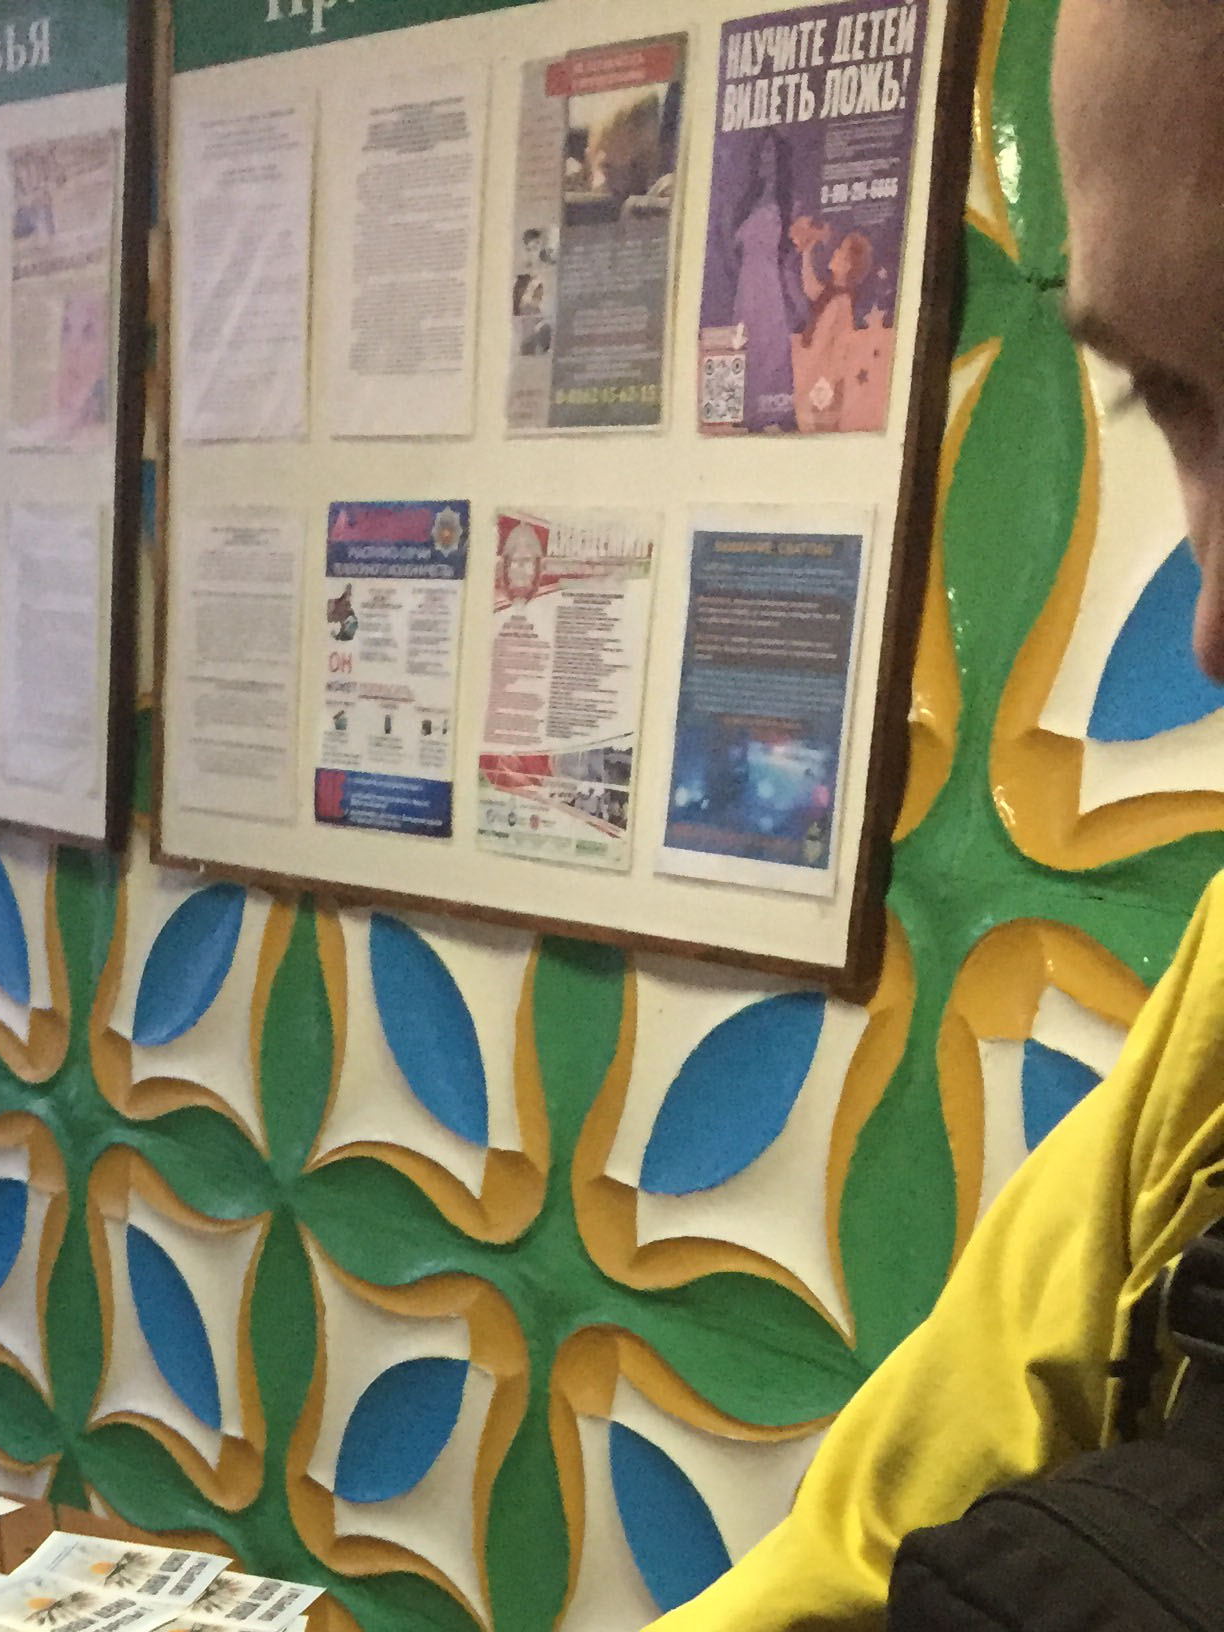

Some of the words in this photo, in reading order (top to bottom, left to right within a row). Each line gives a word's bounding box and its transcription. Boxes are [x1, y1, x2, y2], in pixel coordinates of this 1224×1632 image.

[725, 19, 827, 80] НАУЧИТЕ
[830, 0, 918, 64] ДЕТЕЙ
[721, 72, 816, 132] ВИДЕТЬ
[819, 58, 912, 120] ЛОЖЬ!
